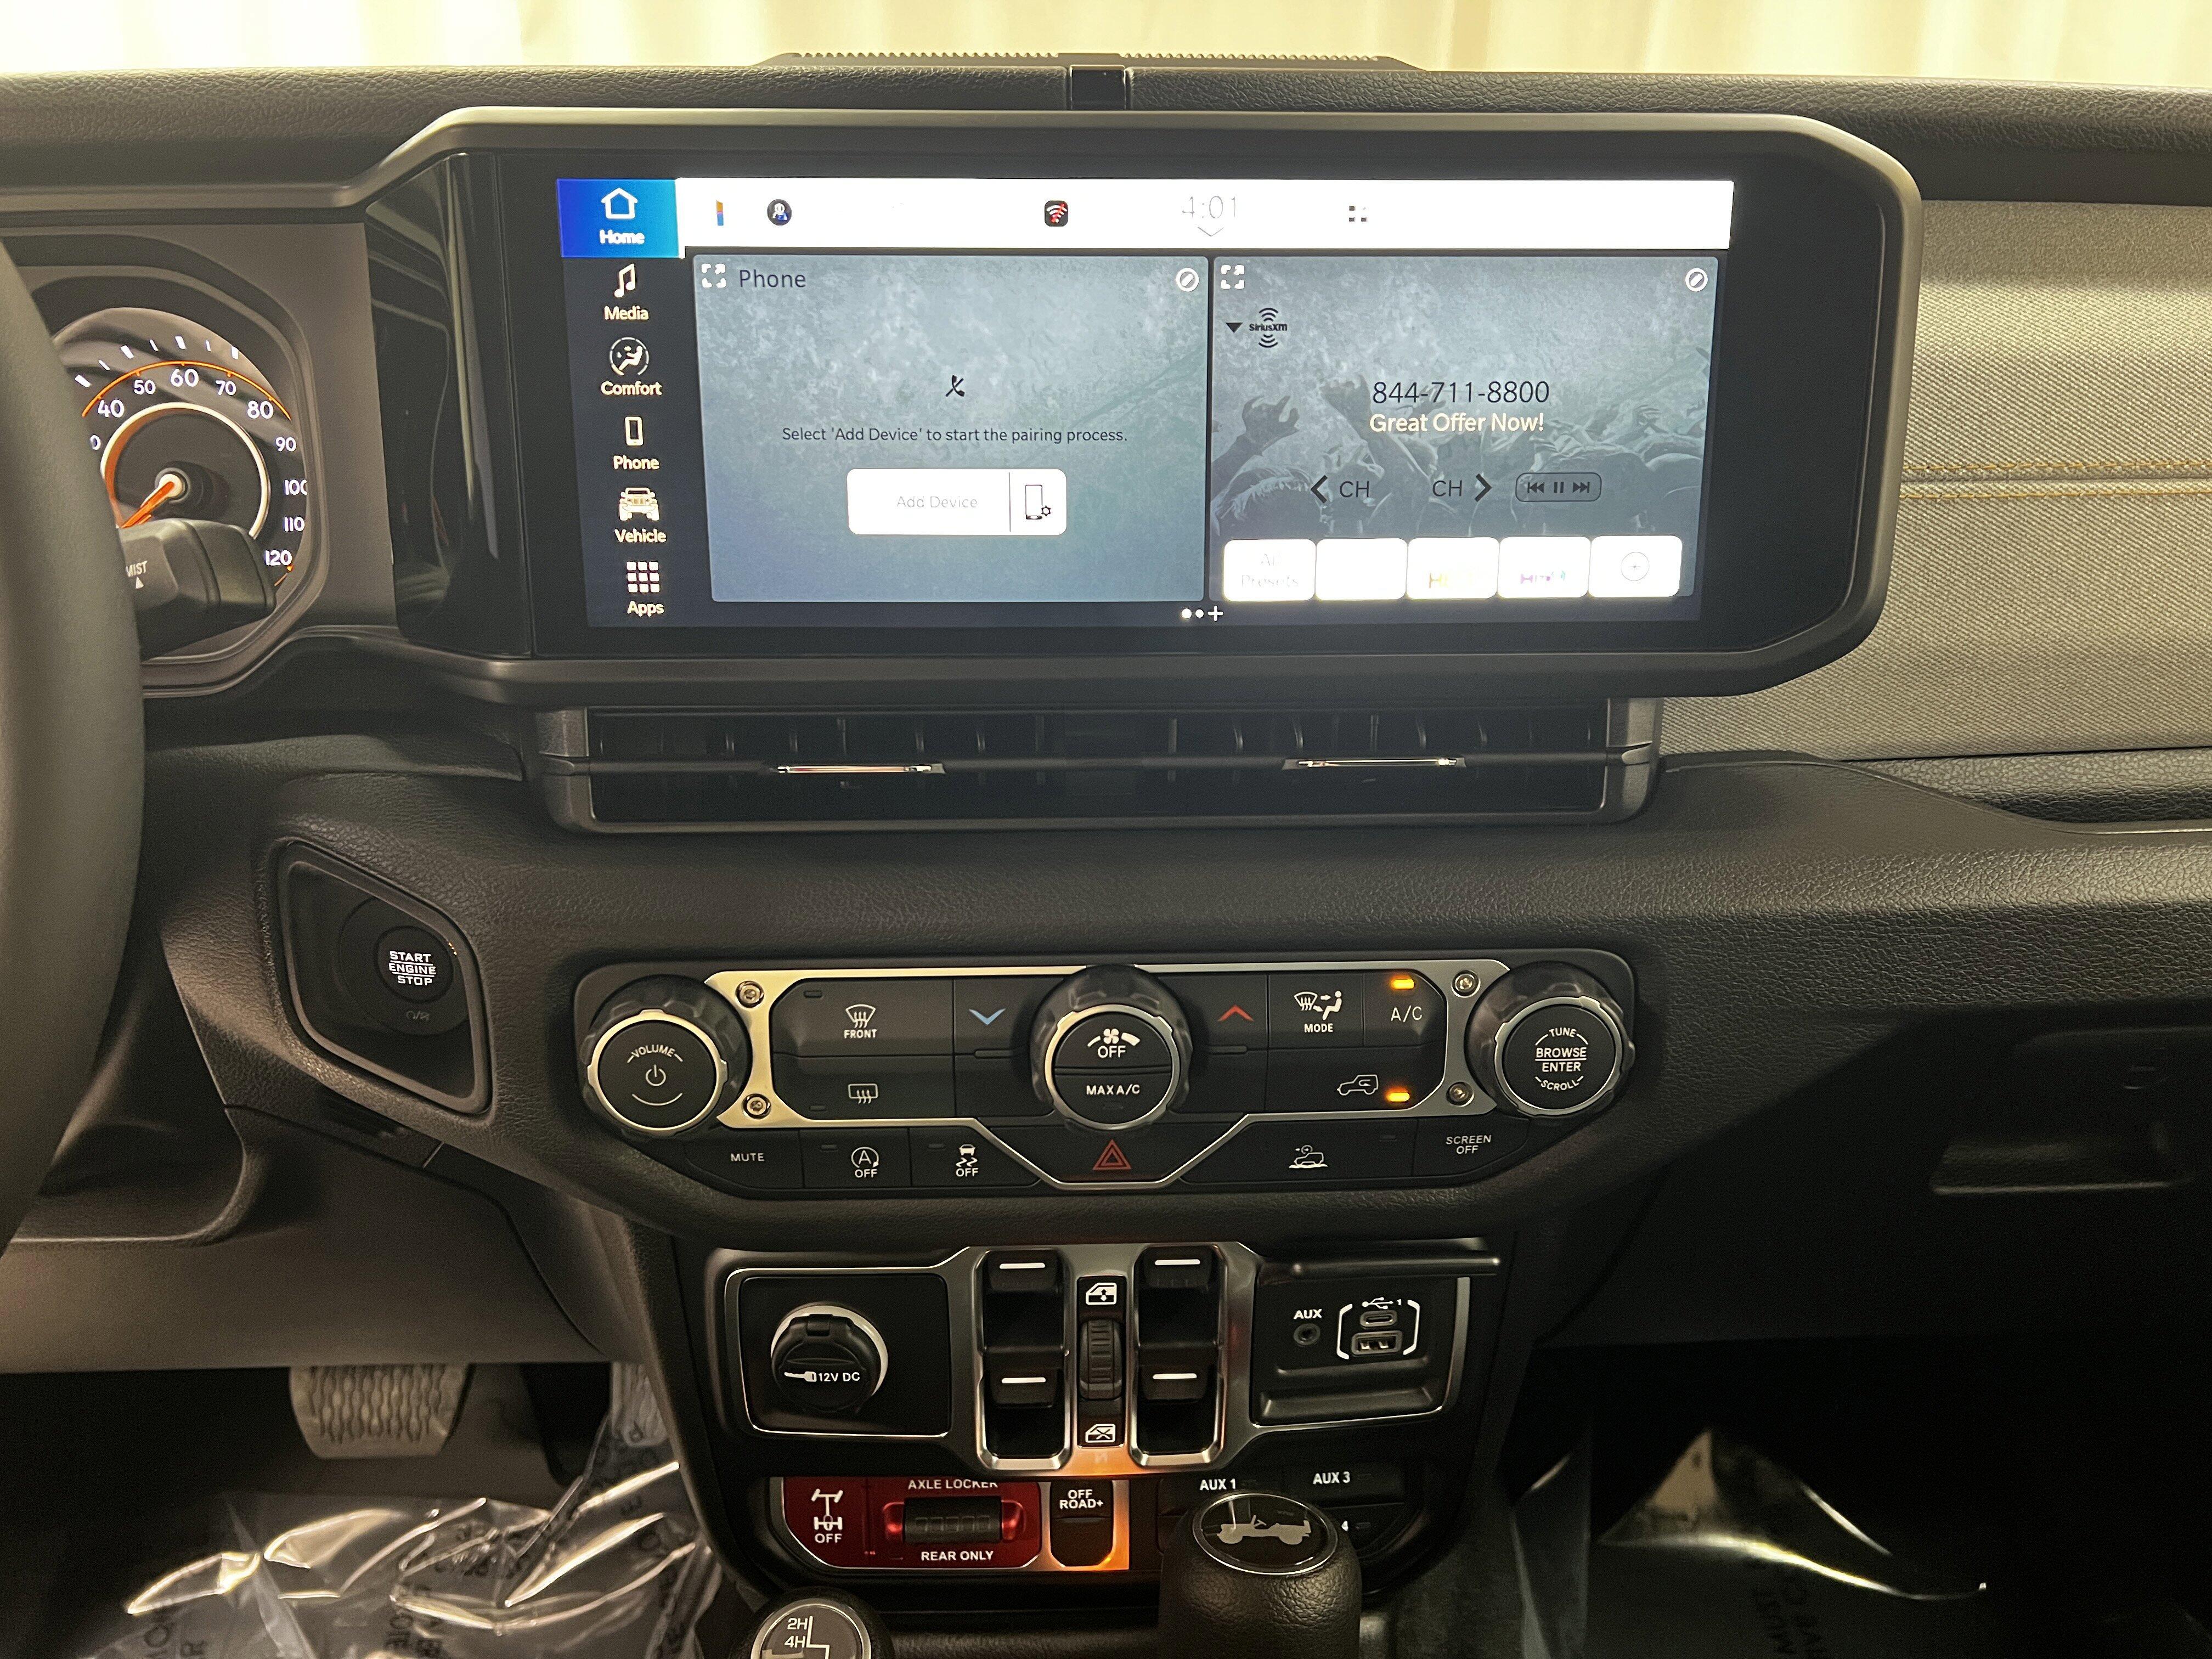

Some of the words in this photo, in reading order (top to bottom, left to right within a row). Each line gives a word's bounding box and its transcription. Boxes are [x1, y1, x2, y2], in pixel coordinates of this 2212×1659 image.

[1181, 195, 1236, 219] 4:01
[600, 229, 645, 245] Home
[739, 268, 806, 289] Phone
[603, 305, 650, 321] Media
[170, 369, 199, 387] 60
[133, 380, 156, 395] 50
[216, 380, 237, 396] 70
[600, 380, 662, 396] Comfort
[1372, 381, 1550, 404] 844-711-8800
[97, 399, 125, 418] 40
[247, 401, 274, 419] 80
[1369, 413, 1429, 433] Great
[1432, 413, 1486, 432] Offer
[1491, 412, 1545, 432] Now!
[782, 427, 826, 441] Select
[831, 427, 865, 442] 'Add
[868, 427, 923, 442] Device'
[926, 430, 941, 442] to
[945, 429, 980, 442] start
[984, 427, 1007, 442] the
[1011, 428, 1062, 444] pairing
[1066, 432, 1128, 445] process.
[275, 437, 297, 452] 90
[613, 455, 661, 470] Phone
[284, 479, 308, 495] 100
[1339, 481, 1370, 498] CH
[1432, 481, 1463, 496] CH
[896, 495, 925, 509] Add
[930, 496, 977, 509] Device
[283, 516, 305, 532] 110
[614, 528, 667, 544] Vehicle
[266, 550, 292, 566] 120
[627, 601, 665, 617] Apps
[390, 951, 431, 963] START
[388, 963, 437, 975] ENGINE
[398, 975, 432, 986] STOP
[1390, 1006, 1423, 1022] A/C
[844, 1029, 877, 1039] FRONT
[1304, 1024, 1333, 1033] MODE
[1549, 1027, 1577, 1038] TUNE
[631, 1045, 675, 1058] VOLUME
[1098, 1045, 1126, 1058] OFF
[1536, 1047, 1587, 1058] BROWSE
[1542, 1062, 1582, 1072] ENTER
[1086, 1085, 1114, 1095] MAX
[1116, 1084, 1140, 1095] A/C
[1541, 1080, 1579, 1091] SCROLL
[1446, 1135, 1492, 1145] SCREEN
[1457, 1146, 1479, 1154] OFF
[731, 1152, 765, 1162] MUTE
[855, 1169, 877, 1178] OFF
[956, 1168, 978, 1177] OFF
[1294, 1309, 1322, 1319] AUX
[818, 1373, 839, 1383] 12V
[843, 1372, 860, 1382] DC
[908, 1479, 942, 1489] AXLE
[1199, 1480, 1226, 1491] AUX
[1230, 1479, 1236, 1490] 1
[1313, 1473, 1340, 1485] AUX
[1342, 1472, 1351, 1483] 3
[1068, 1489, 1093, 1499] OFF
[1059, 1499, 1104, 1509] ROAD+
[814, 1534, 842, 1543] OFF
[921, 1551, 957, 1561] REAR
[960, 1550, 994, 1561] ONLY
[787, 1618, 808, 1630] 2H
[784, 1635, 806, 1648] 4H
